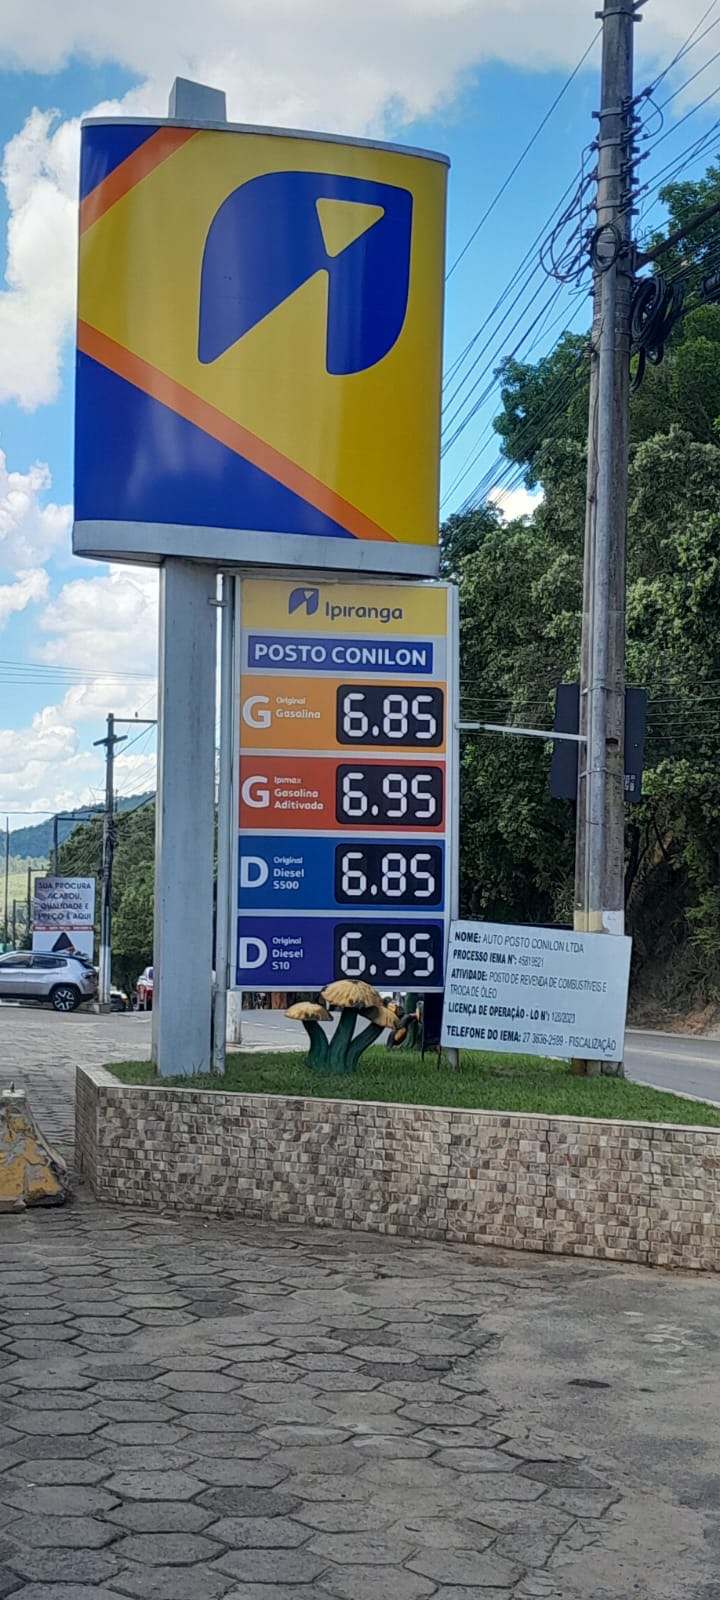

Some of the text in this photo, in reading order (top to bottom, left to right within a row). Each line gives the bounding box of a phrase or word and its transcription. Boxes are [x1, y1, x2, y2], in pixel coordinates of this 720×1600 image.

[325, 602, 403, 623] Ipiranga
[254, 644, 427, 666] POSTO CONILON
[275, 696, 306, 705] Original
[242, 695, 272, 729] G
[275, 708, 321, 719] Gasolina
[343, 692, 437, 740] 6.85
[274, 776, 302, 784] Ipimax
[241, 775, 270, 809] G
[274, 788, 319, 798] Gasolina
[342, 772, 436, 818] 6.95
[274, 800, 324, 810] Aditivada
[273, 857, 303, 866] Original
[239, 856, 269, 888] D
[273, 868, 305, 878] Diesel
[341, 852, 435, 898] 6.85
[273, 880, 300, 890] S500
[271, 937, 302, 946] Original
[455, 931, 584, 953] NOME: AUTO POSTO CONILON LTDA
[238, 936, 268, 969] D
[271, 948, 303, 959] Diesel
[340, 931, 435, 977] 6.95
[453, 949, 488, 962] PROCESSO
[489, 952, 506, 964] IEMA
[271, 961, 290, 970] S10
[451, 968, 488, 981] ATIVIDADE:
[489, 971, 510, 983] POSTO
[510, 973, 520, 984] DE
[520, 974, 548, 987] REVENDA
[549, 977, 558, 988] DE
[602, 982, 608, 993] E
[450, 984, 498, 999] TROCA DE ÓLEO
[448, 1002, 477, 1016] LICENÇA
[479, 1004, 488, 1016] DE
[489, 1005, 525, 1021] OPERAÇÃO
[530, 1008, 540, 1020] LO
[447, 1025, 486, 1039] TELEFONE
[487, 1028, 499, 1040] DO
[500, 1030, 521, 1043] IEMA:
[569, 1035, 617, 1053] FISCALIZAÇÃO
